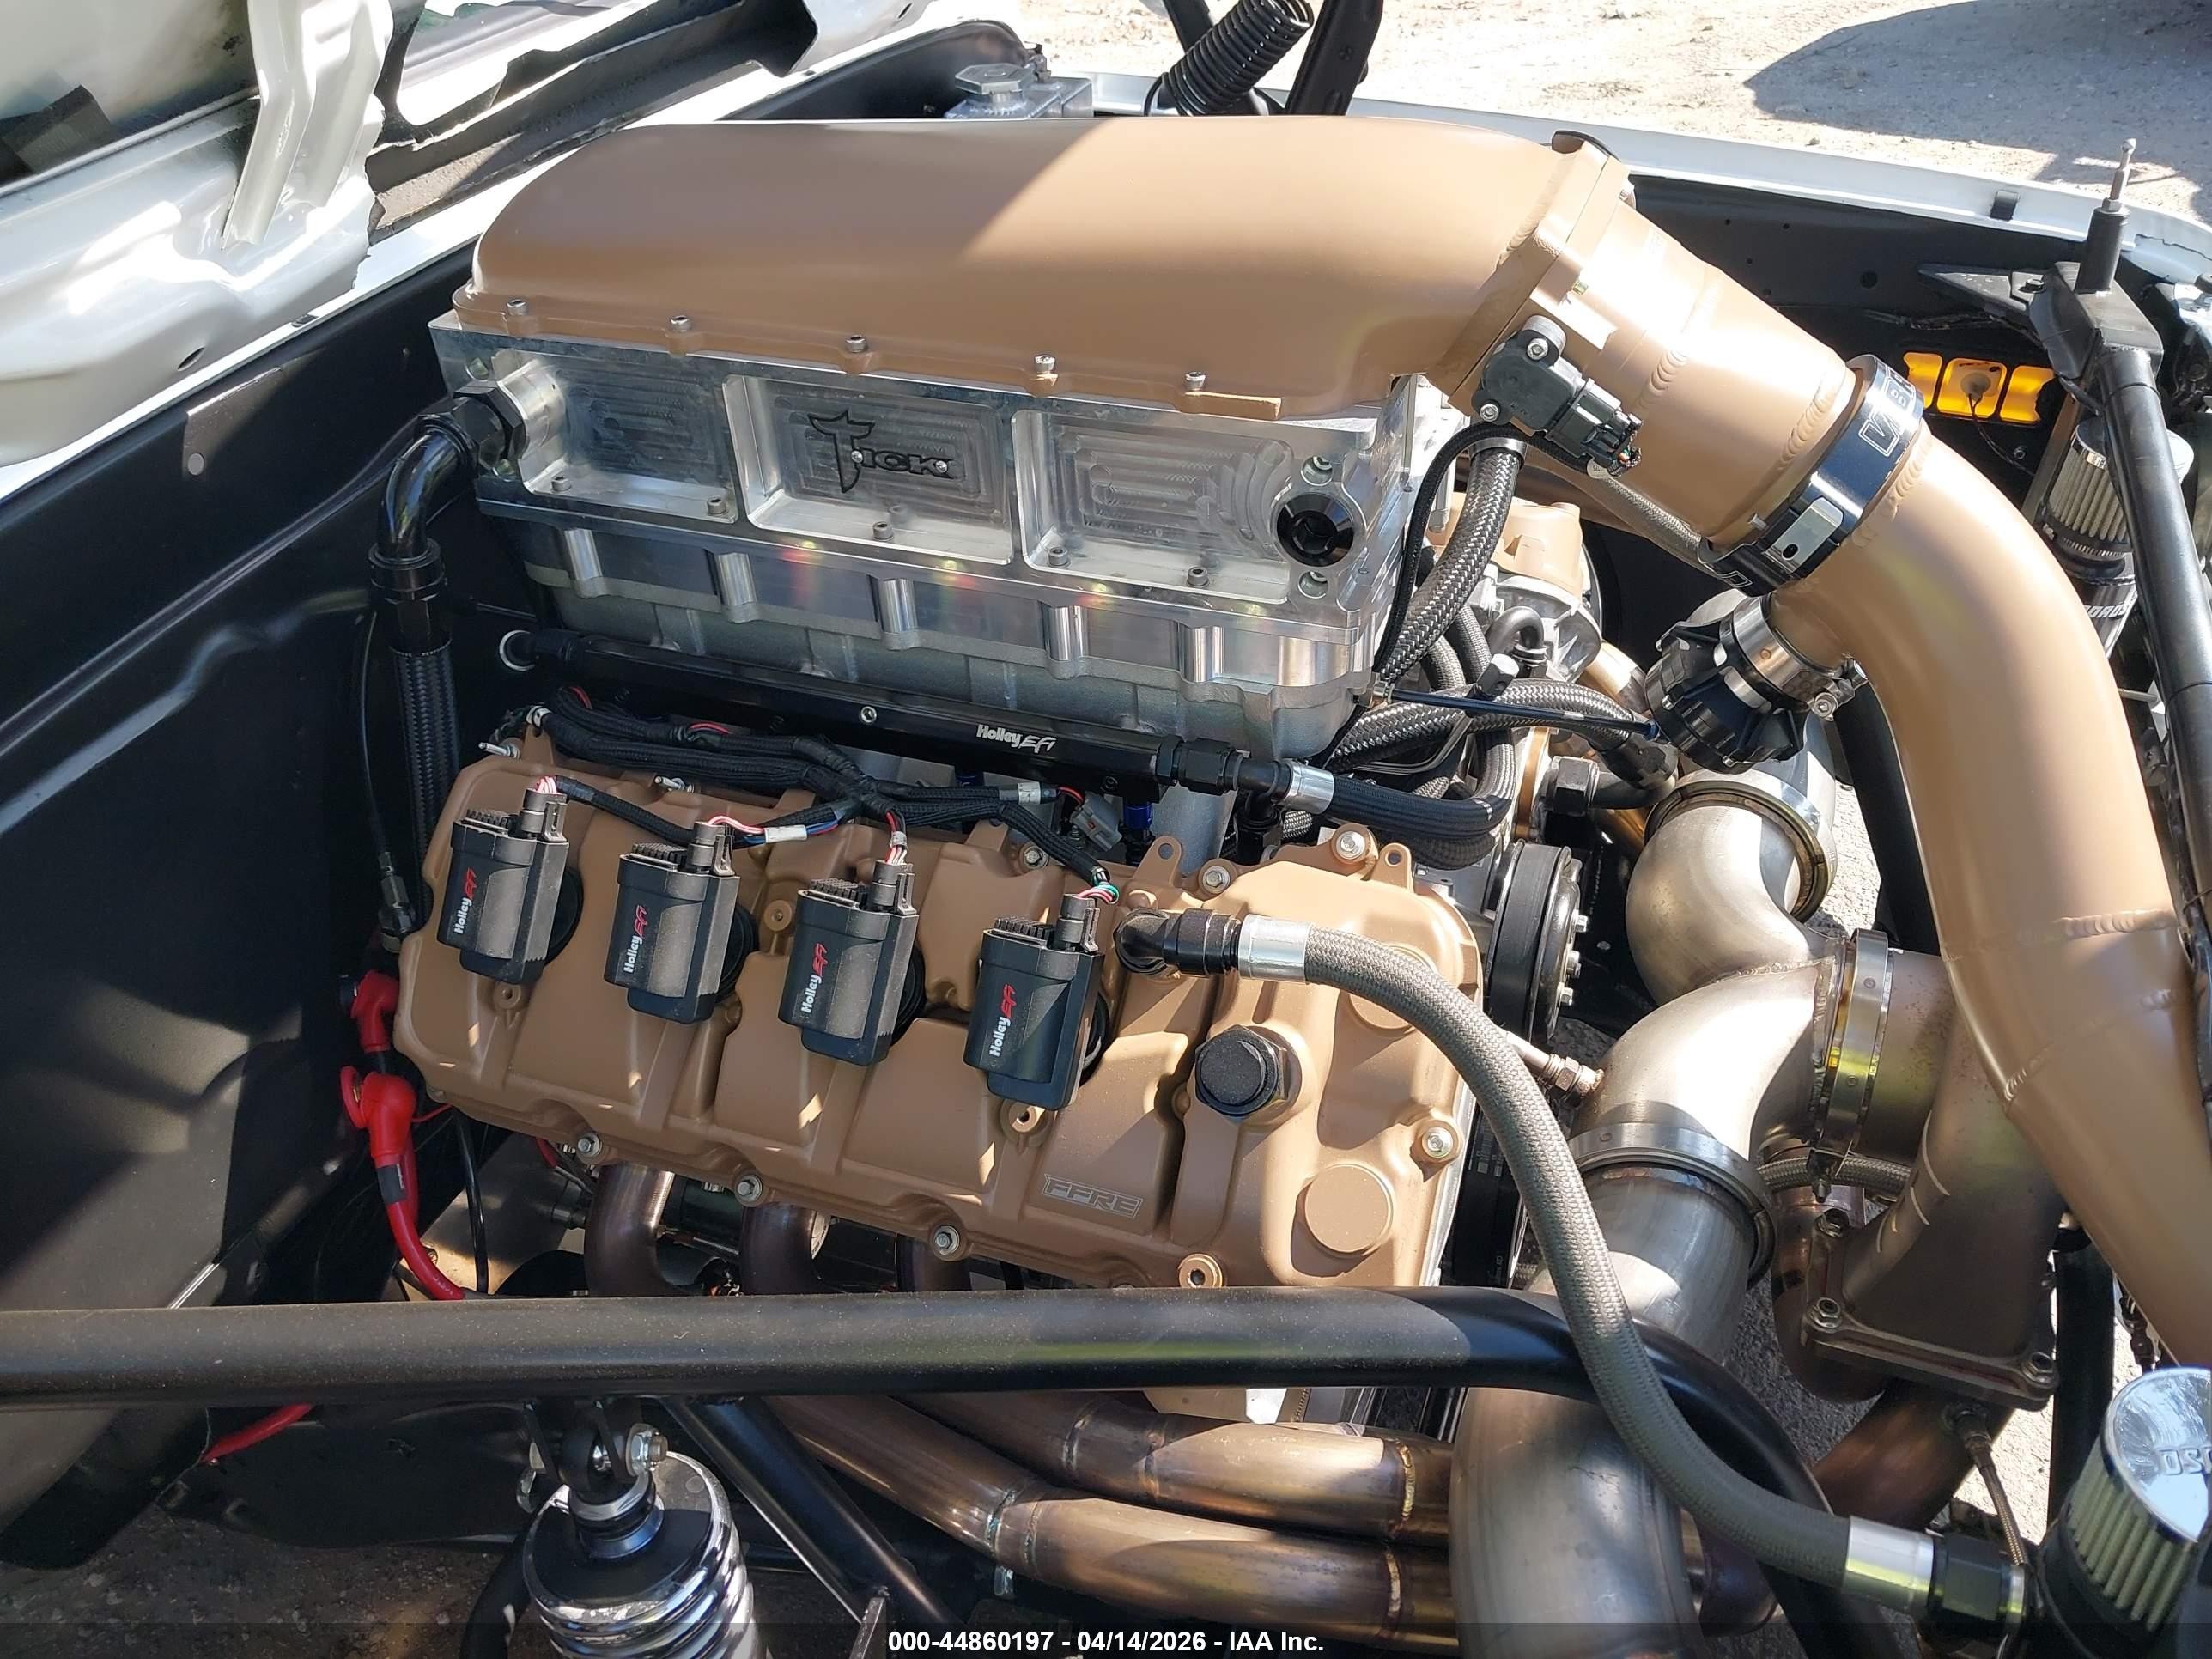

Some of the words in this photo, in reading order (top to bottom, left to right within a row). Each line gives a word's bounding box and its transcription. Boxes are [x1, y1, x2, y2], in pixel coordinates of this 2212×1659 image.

[976, 724, 1023, 748] Holley
[1018, 734, 1056, 753] EFI
[453, 897, 472, 934] Holley
[464, 866, 477, 900] EFI
[623, 935, 643, 973] Holley
[634, 904, 648, 939] EFI
[800, 974, 822, 1013] Holley
[812, 943, 829, 977] EFI
[988, 1016, 1011, 1057] Holley
[1000, 983, 1016, 1020] EFI
